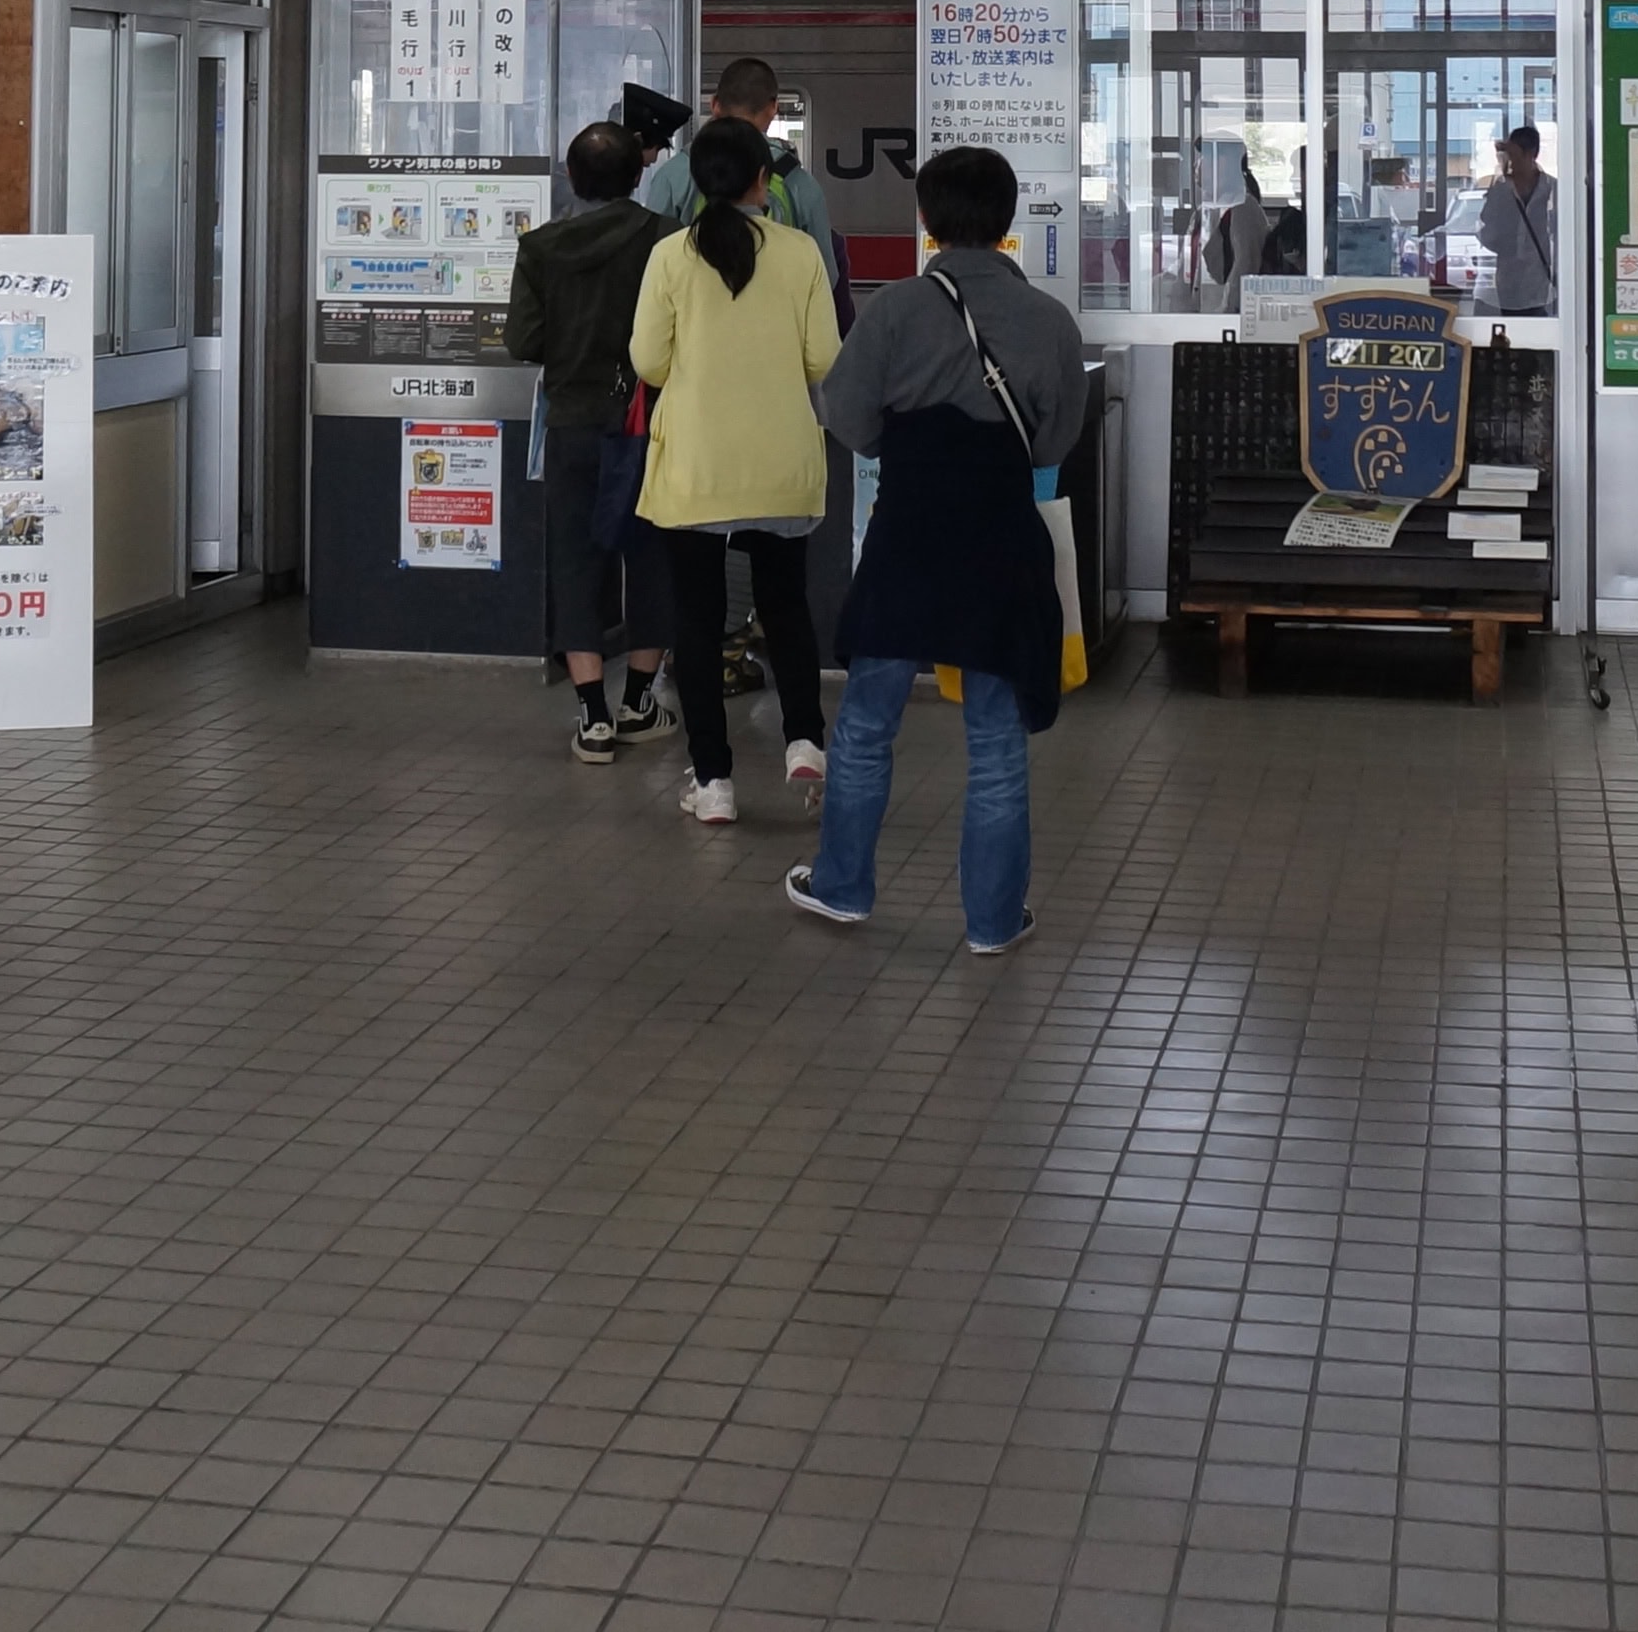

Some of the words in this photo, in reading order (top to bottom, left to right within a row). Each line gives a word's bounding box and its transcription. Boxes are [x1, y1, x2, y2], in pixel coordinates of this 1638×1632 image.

[930, 3, 1049, 23] 16時20分から
[930, 25, 1067, 45] 翌日7時50分まで
[930, 49, 1054, 66] 改札・放送案内は
[397, 66, 423, 77] のりば
[930, 71, 1033, 88] いたしません。
[406, 79, 414, 97] 1
[453, 79, 461, 97] 1
[930, 115, 1065, 128] たら、ホームに出て乗車口
[930, 131, 1066, 145] 案内札の前でお待ちくだ
[826, 127, 917, 179] JR
[368, 157, 502, 170] ワンマン列車の乗り降り
[1338, 312, 1436, 333] SUZURAN
[1389, 345, 1436, 366] 207
[393, 379, 475, 397] JR北海道
[1317, 374, 1451, 424] すずらん
